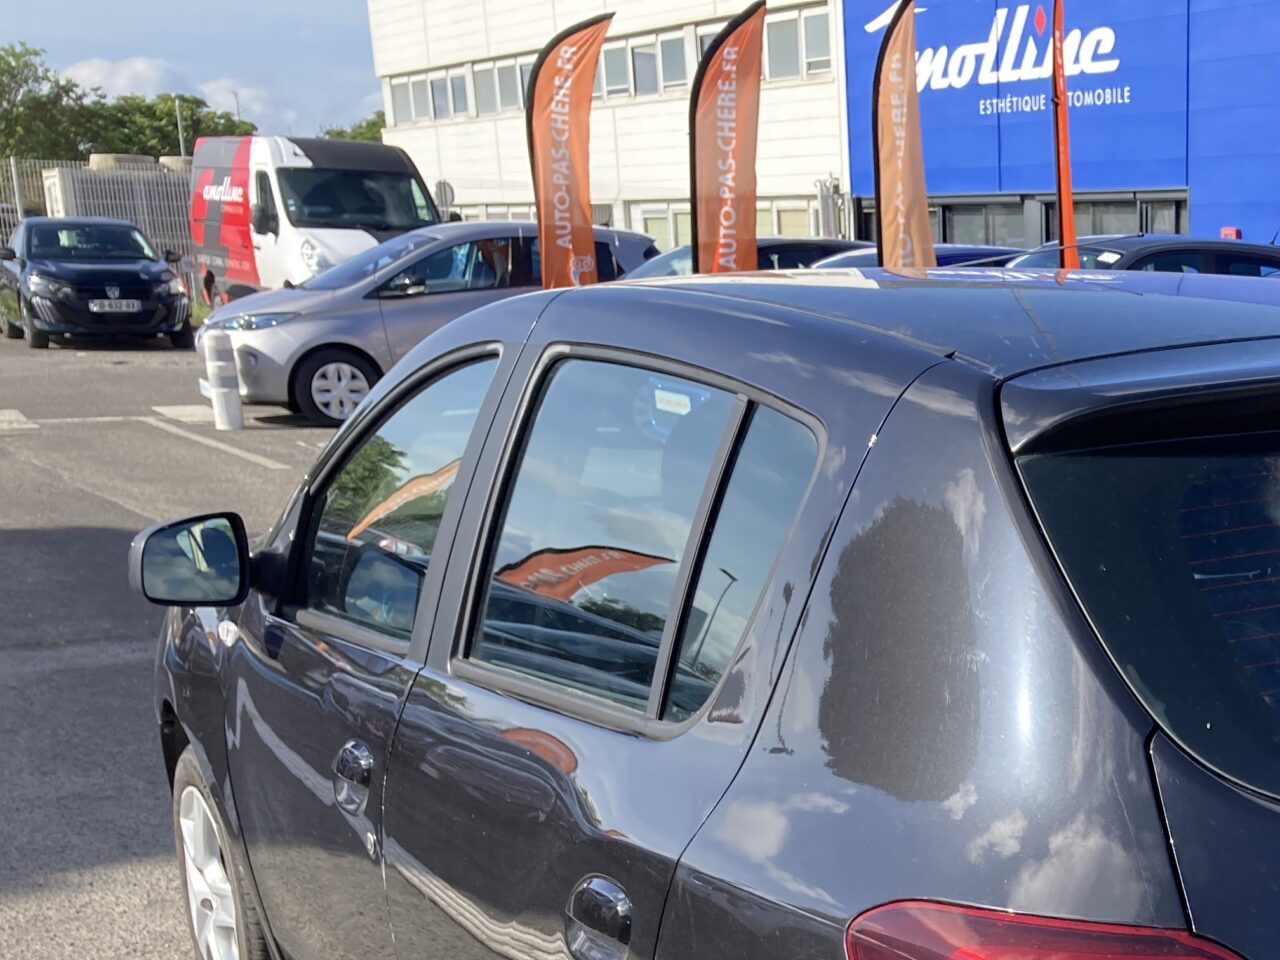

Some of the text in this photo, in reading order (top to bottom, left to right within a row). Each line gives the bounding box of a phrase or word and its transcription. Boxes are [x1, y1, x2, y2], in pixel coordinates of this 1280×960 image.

[716, 46, 738, 269] AUTO-PAS-CHERE.FR
[979, 86, 1131, 115] ESTHÉTIQUE TOMOBILE
